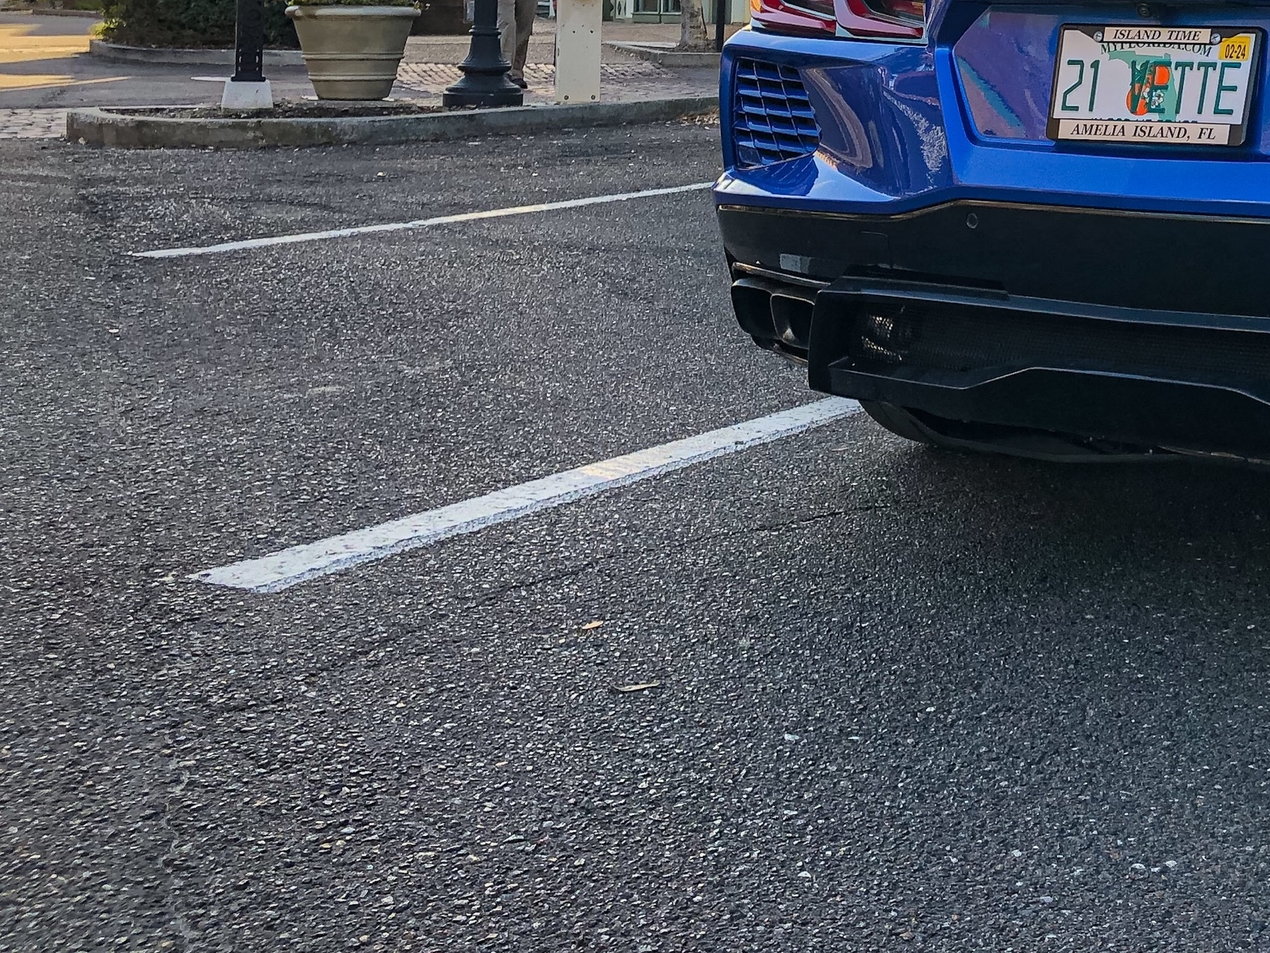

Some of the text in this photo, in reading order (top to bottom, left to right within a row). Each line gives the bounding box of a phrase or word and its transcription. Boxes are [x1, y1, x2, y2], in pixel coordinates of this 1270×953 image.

[1113, 29, 1202, 41] ISLAND TIME
[1225, 43, 1247, 59] 02-24
[1061, 59, 1242, 115] 21 VETTE
[1070, 123, 1216, 141] AMELIA ISLAND, FL
